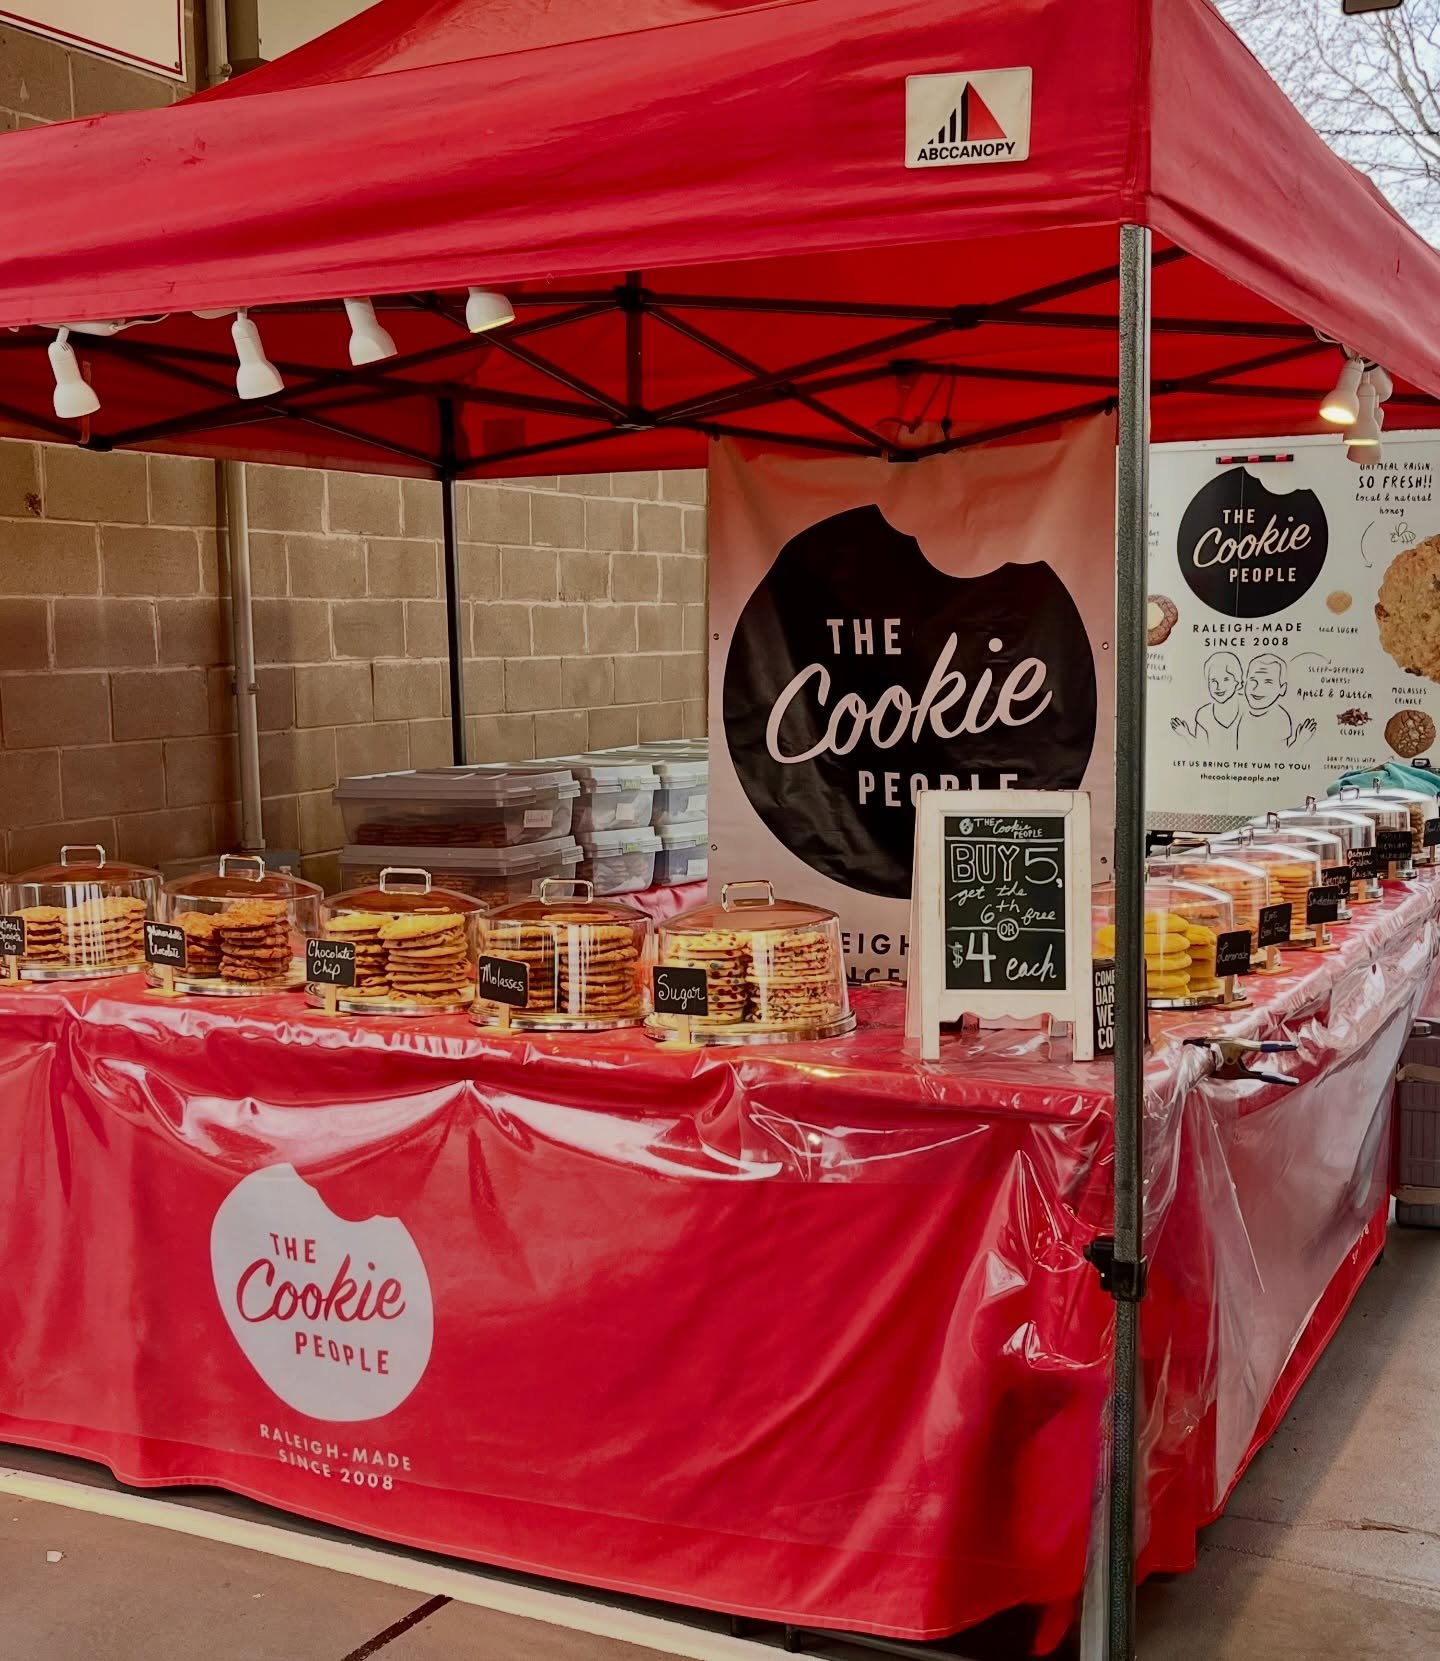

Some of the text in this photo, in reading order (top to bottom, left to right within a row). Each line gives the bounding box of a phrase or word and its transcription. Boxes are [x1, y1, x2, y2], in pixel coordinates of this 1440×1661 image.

[917, 142, 1016, 161] ABCCANOPY
[1359, 474, 1432, 488] SO FRESH!!
[1355, 493, 1381, 501] local
[1394, 493, 1432, 501] natural
[1223, 509, 1256, 524] THE
[1380, 506, 1404, 517] honey
[1193, 514, 1311, 567] Cookie
[1229, 568, 1297, 583] PEOPLE
[827, 618, 902, 655] THE
[1193, 622, 1303, 633] RALEIGH-MADE
[1204, 637, 1289, 647] SINCE 2008
[1308, 666, 1365, 674] SLEEP-DEPRIVED
[766, 632, 1053, 764] Cookie
[1297, 688, 1324, 700] April
[1328, 689, 1334, 697] &
[1392, 687, 1427, 695] MOLASSES
[1200, 773, 1280, 782] thecookiepeople.net
[974, 818, 1031, 835] THE Cookie
[1014, 829, 1043, 839] PEOPLE
[951, 843, 1020, 884] BUY
[949, 881, 1028, 906] get the
[980, 899, 1057, 925] 6th free
[999, 923, 1016, 936] OR
[308, 940, 356, 960] Chocolate
[313, 959, 341, 980] Chip
[1005, 943, 1057, 983] each
[658, 974, 705, 1011] Sugar
[1096, 1004, 1115, 1027] WE
[270, 1232, 317, 1264] THE
[236, 1253, 406, 1323] Cookie
[295, 1331, 390, 1375] PEOPLE
[259, 1424, 412, 1471] RALEIGH-MADE
[279, 1449, 394, 1491] SINCE 2008
